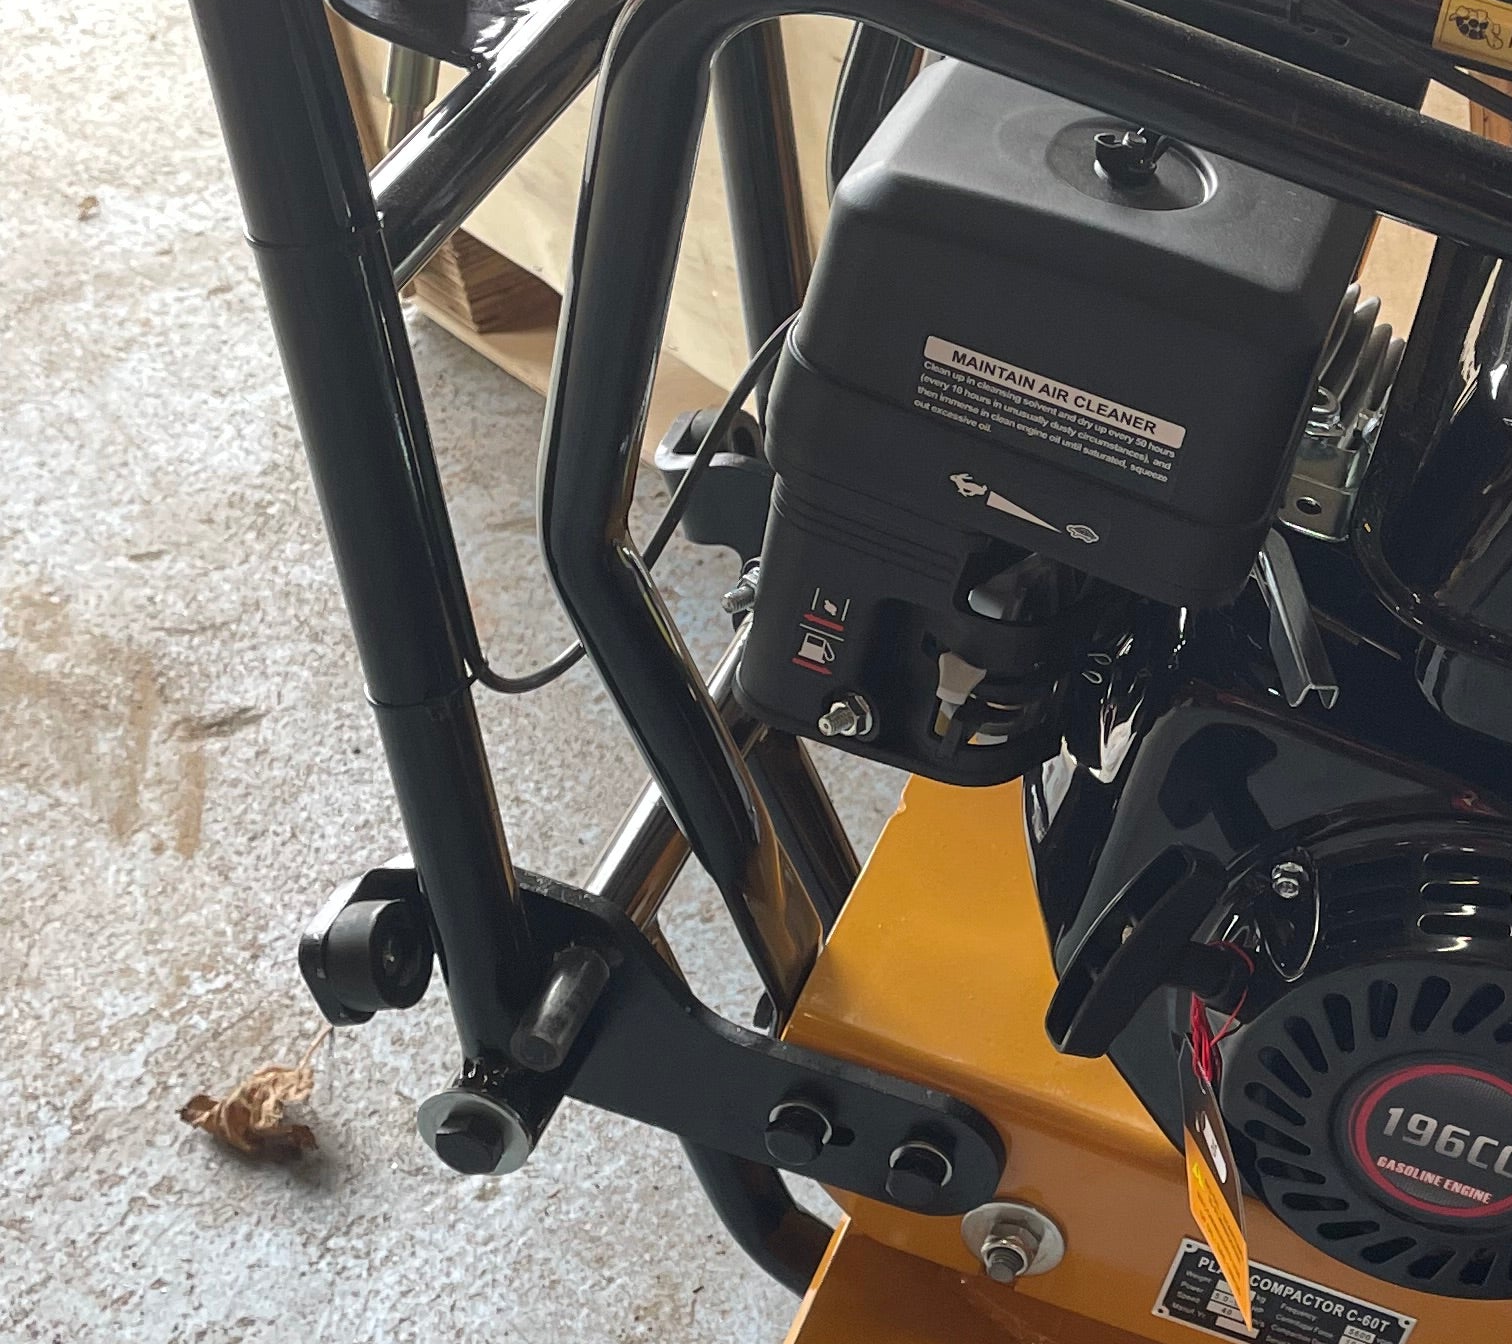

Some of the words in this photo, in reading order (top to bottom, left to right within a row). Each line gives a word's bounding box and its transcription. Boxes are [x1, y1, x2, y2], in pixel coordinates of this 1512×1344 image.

[913, 399, 930, 410] out
[930, 405, 977, 426] excessive
[920, 372, 950, 391] (every
[949, 384, 963, 394] 10
[963, 388, 991, 407] hours
[992, 398, 1003, 409] in
[1003, 404, 1049, 427] unusually
[1049, 420, 1077, 437] dusty
[1152, 458, 1171, 470] and
[923, 360, 951, 377] Clean
[951, 369, 965, 384] up
[965, 375, 976, 385] in
[976, 379, 1021, 404] cleansing
[1022, 397, 1057, 415] solvent
[1057, 408, 1077, 422] and
[1076, 415, 1093, 429] dry
[1094, 421, 1107, 434] up
[1107, 429, 1135, 444] every
[1134, 437, 1147, 447] 50
[1147, 441, 1175, 458] hours
[951, 350, 1035, 389] MAINTAIN
[1037, 383, 1068, 403] AIR
[1073, 395, 1156, 434] CLEANER
[917, 385, 938, 399] then
[939, 393, 979, 414] immerse
[979, 407, 989, 418] in
[990, 413, 1015, 427] clean
[1015, 420, 1047, 439] engine
[1048, 433, 1061, 443] oil
[1061, 439, 1082, 451] until
[1129, 463, 1167, 482] squeeze
[1376, 1156, 1443, 1187] GASOLINE
[1443, 1179, 1492, 1205] ENGINE
[1220, 1306, 1233, 1316] 40
[1250, 1274, 1344, 1316] COMPACTOR
[1345, 1309, 1390, 1331] C-60T
